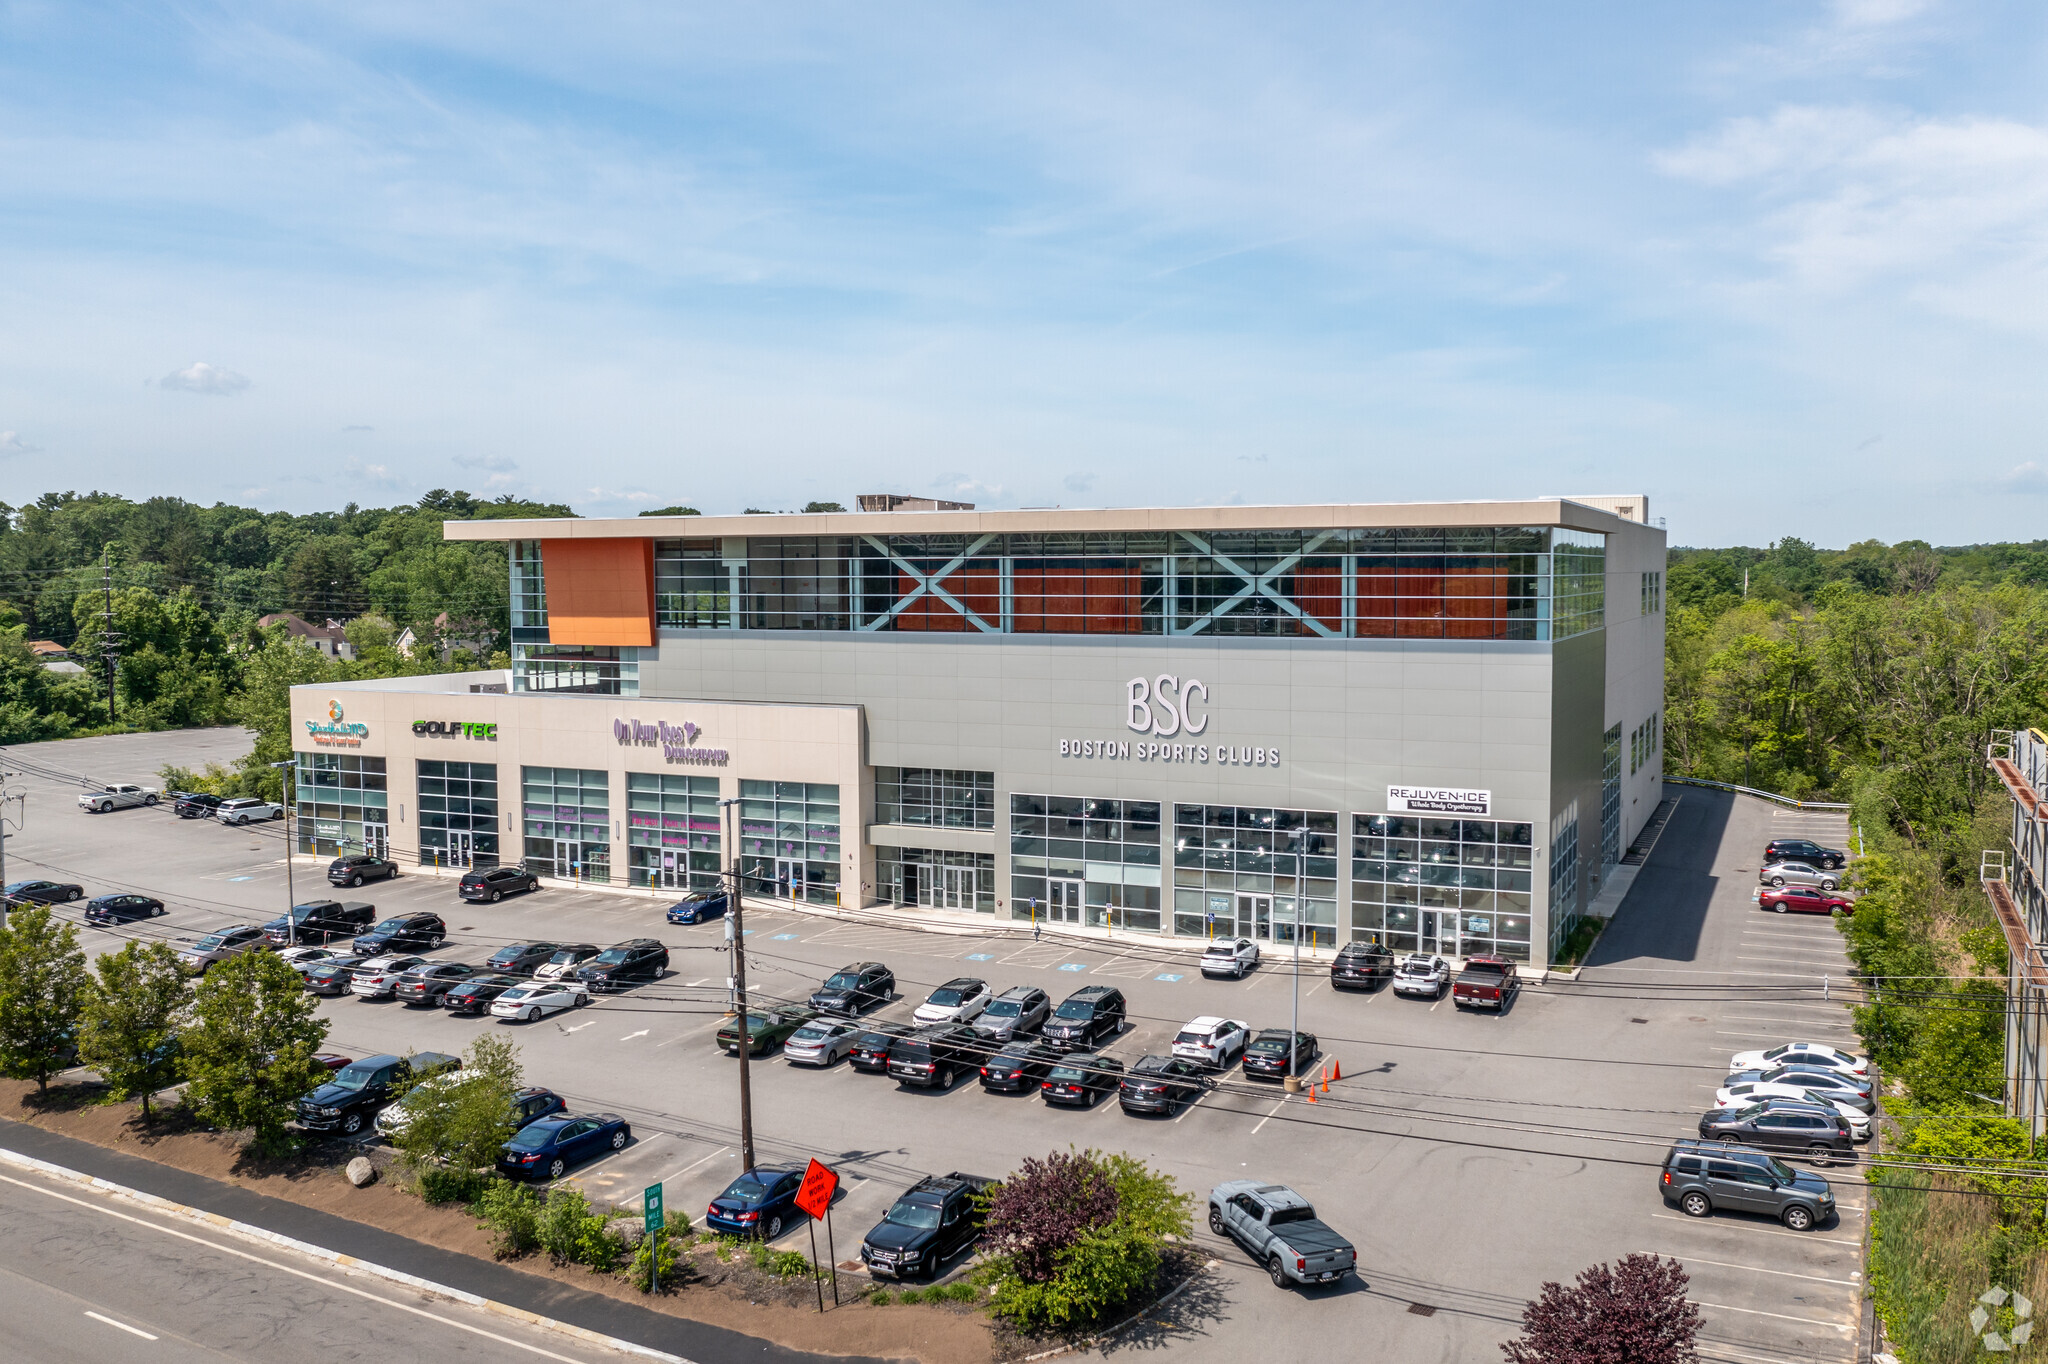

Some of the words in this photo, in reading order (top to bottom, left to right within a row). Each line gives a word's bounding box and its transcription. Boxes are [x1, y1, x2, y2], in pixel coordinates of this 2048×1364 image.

[1126, 674, 1208, 736] BSC
[412, 720, 497, 737] GOLFTEC
[613, 718, 630, 740] On
[630, 719, 657, 741] Your
[658, 720, 684, 743] Toes
[663, 743, 728, 760] Dancewear
[1059, 738, 1131, 758] BOSTON
[1136, 741, 1209, 761] SPORTS
[1216, 745, 1280, 765] CLUBS
[1390, 788, 1488, 802] REJUVEN-ICE
[1411, 801, 1430, 809] Whole
[1430, 802, 1446, 810] Body
[1447, 803, 1483, 813] Cryotherapy
[807, 1171, 824, 1186] ROAD
[809, 1182, 825, 1197] WORK
[817, 1192, 829, 1205] MILE
[648, 1210, 660, 1220] MILE
